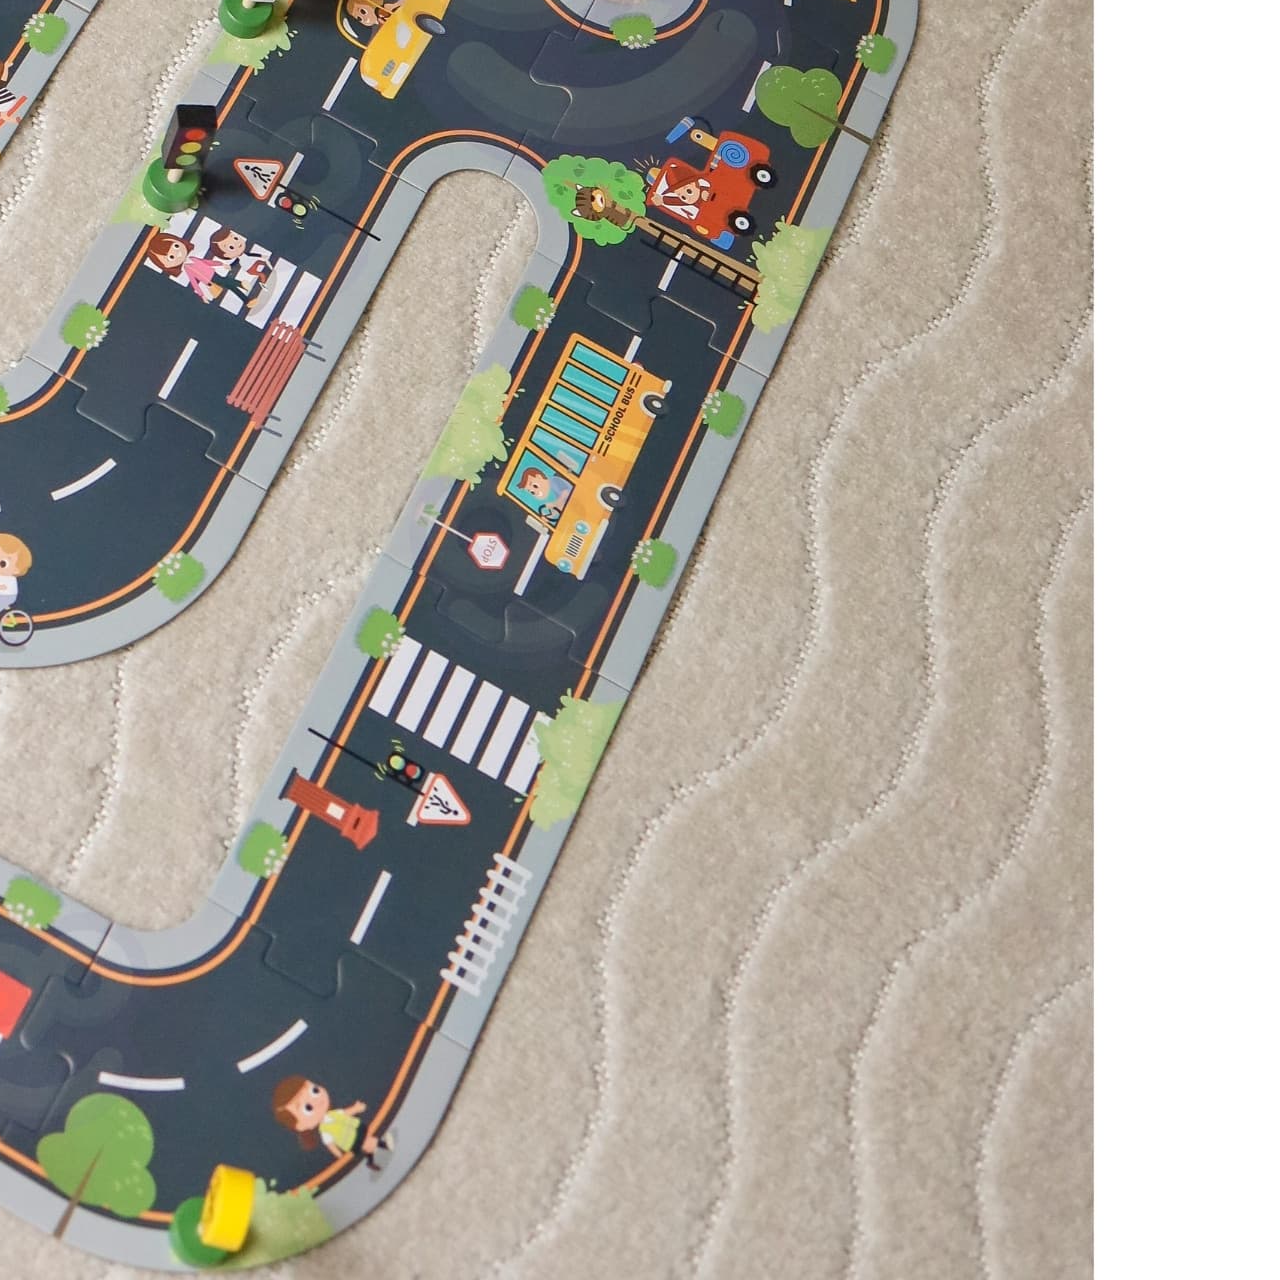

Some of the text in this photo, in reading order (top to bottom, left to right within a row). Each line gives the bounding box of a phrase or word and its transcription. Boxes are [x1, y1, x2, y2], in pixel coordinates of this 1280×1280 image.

[604, 386, 636, 443] SCHOOL BUS
[480, 538, 498, 563] STOP
